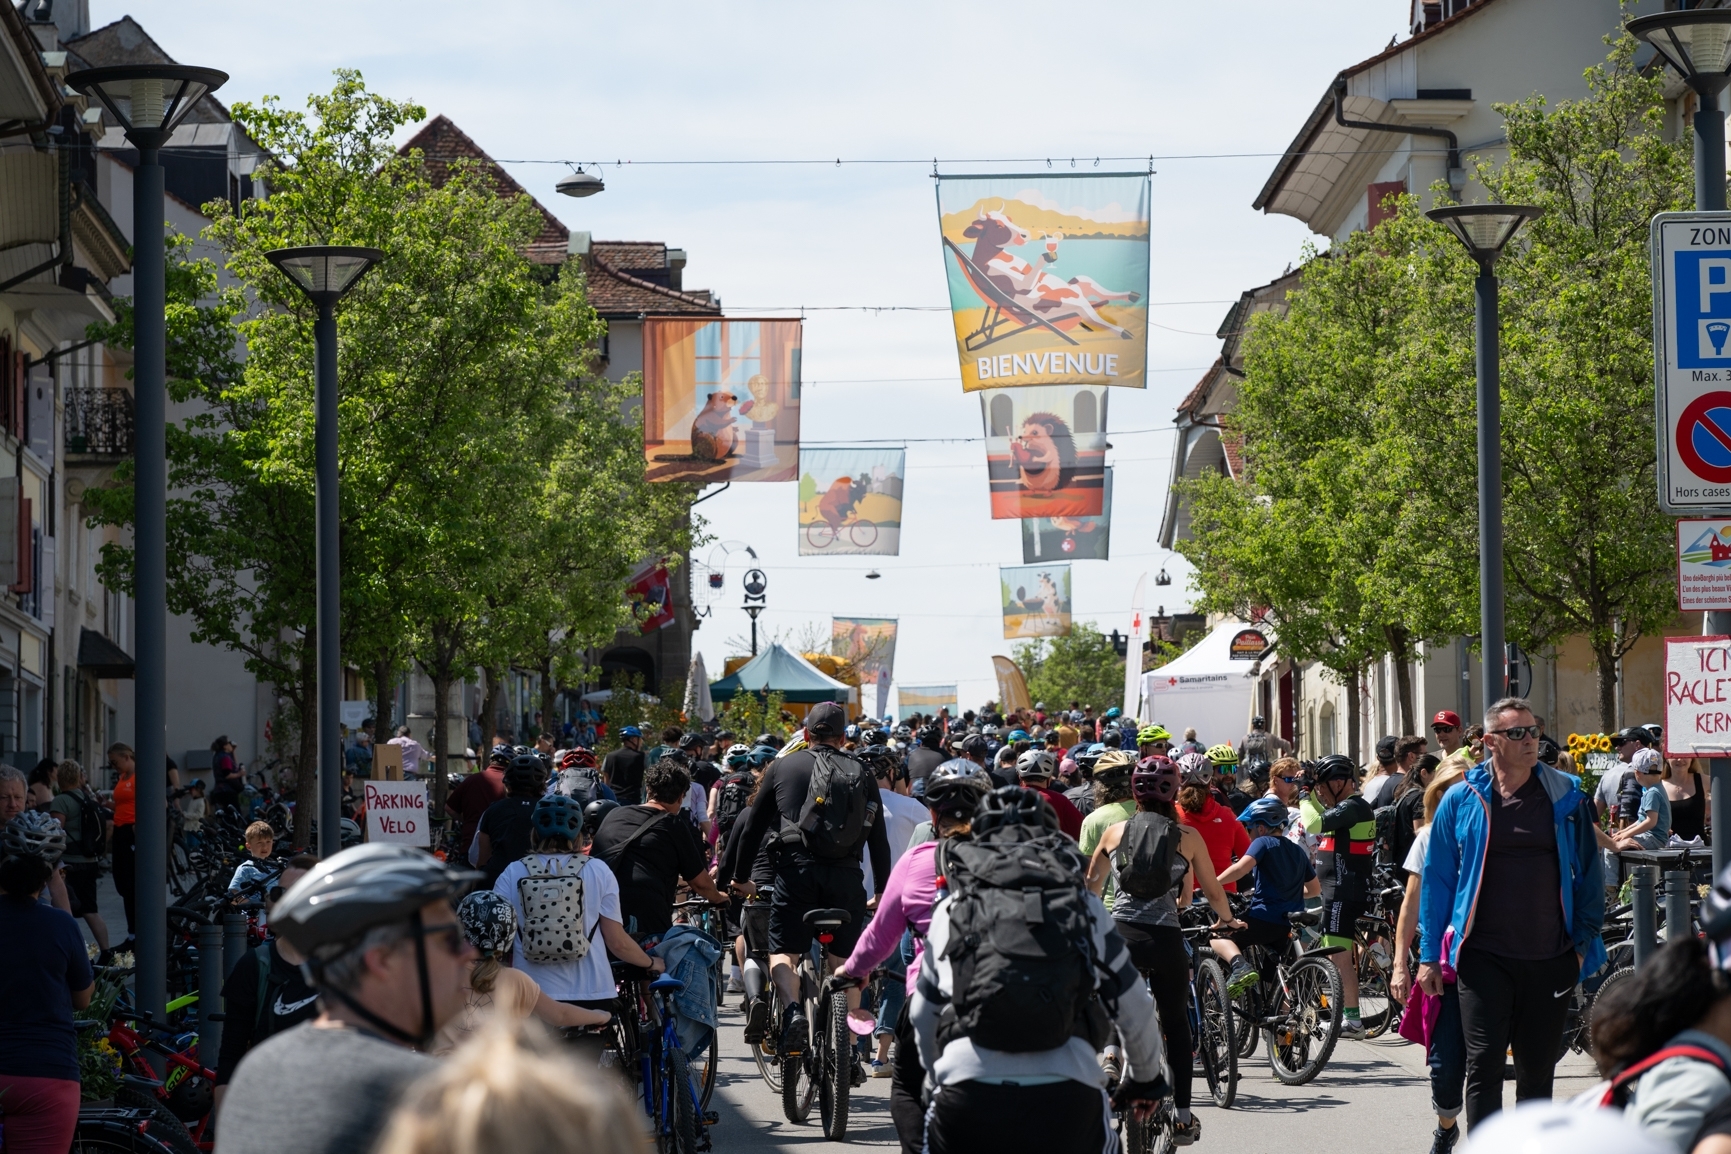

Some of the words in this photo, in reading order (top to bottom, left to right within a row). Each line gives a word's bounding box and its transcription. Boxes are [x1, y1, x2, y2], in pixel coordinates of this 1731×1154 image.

[1690, 228, 1730, 246] ZON
[1699, 258, 1731, 313] P
[977, 352, 1118, 380] BIENVENUE
[1692, 370, 1721, 382] Max.
[1726, 370, 1731, 381] 3
[1676, 486, 1699, 497] Hors
[1702, 488, 1730, 497] cases
[1702, 585, 1711, 594] plus
[1701, 648, 1727, 672] ICI
[1179, 675, 1227, 683] Samaritains
[1668, 671, 1731, 706] RACLE
[1438, 711, 1446, 720] S
[366, 785, 424, 810] PARKING
[379, 816, 416, 833] VELO
